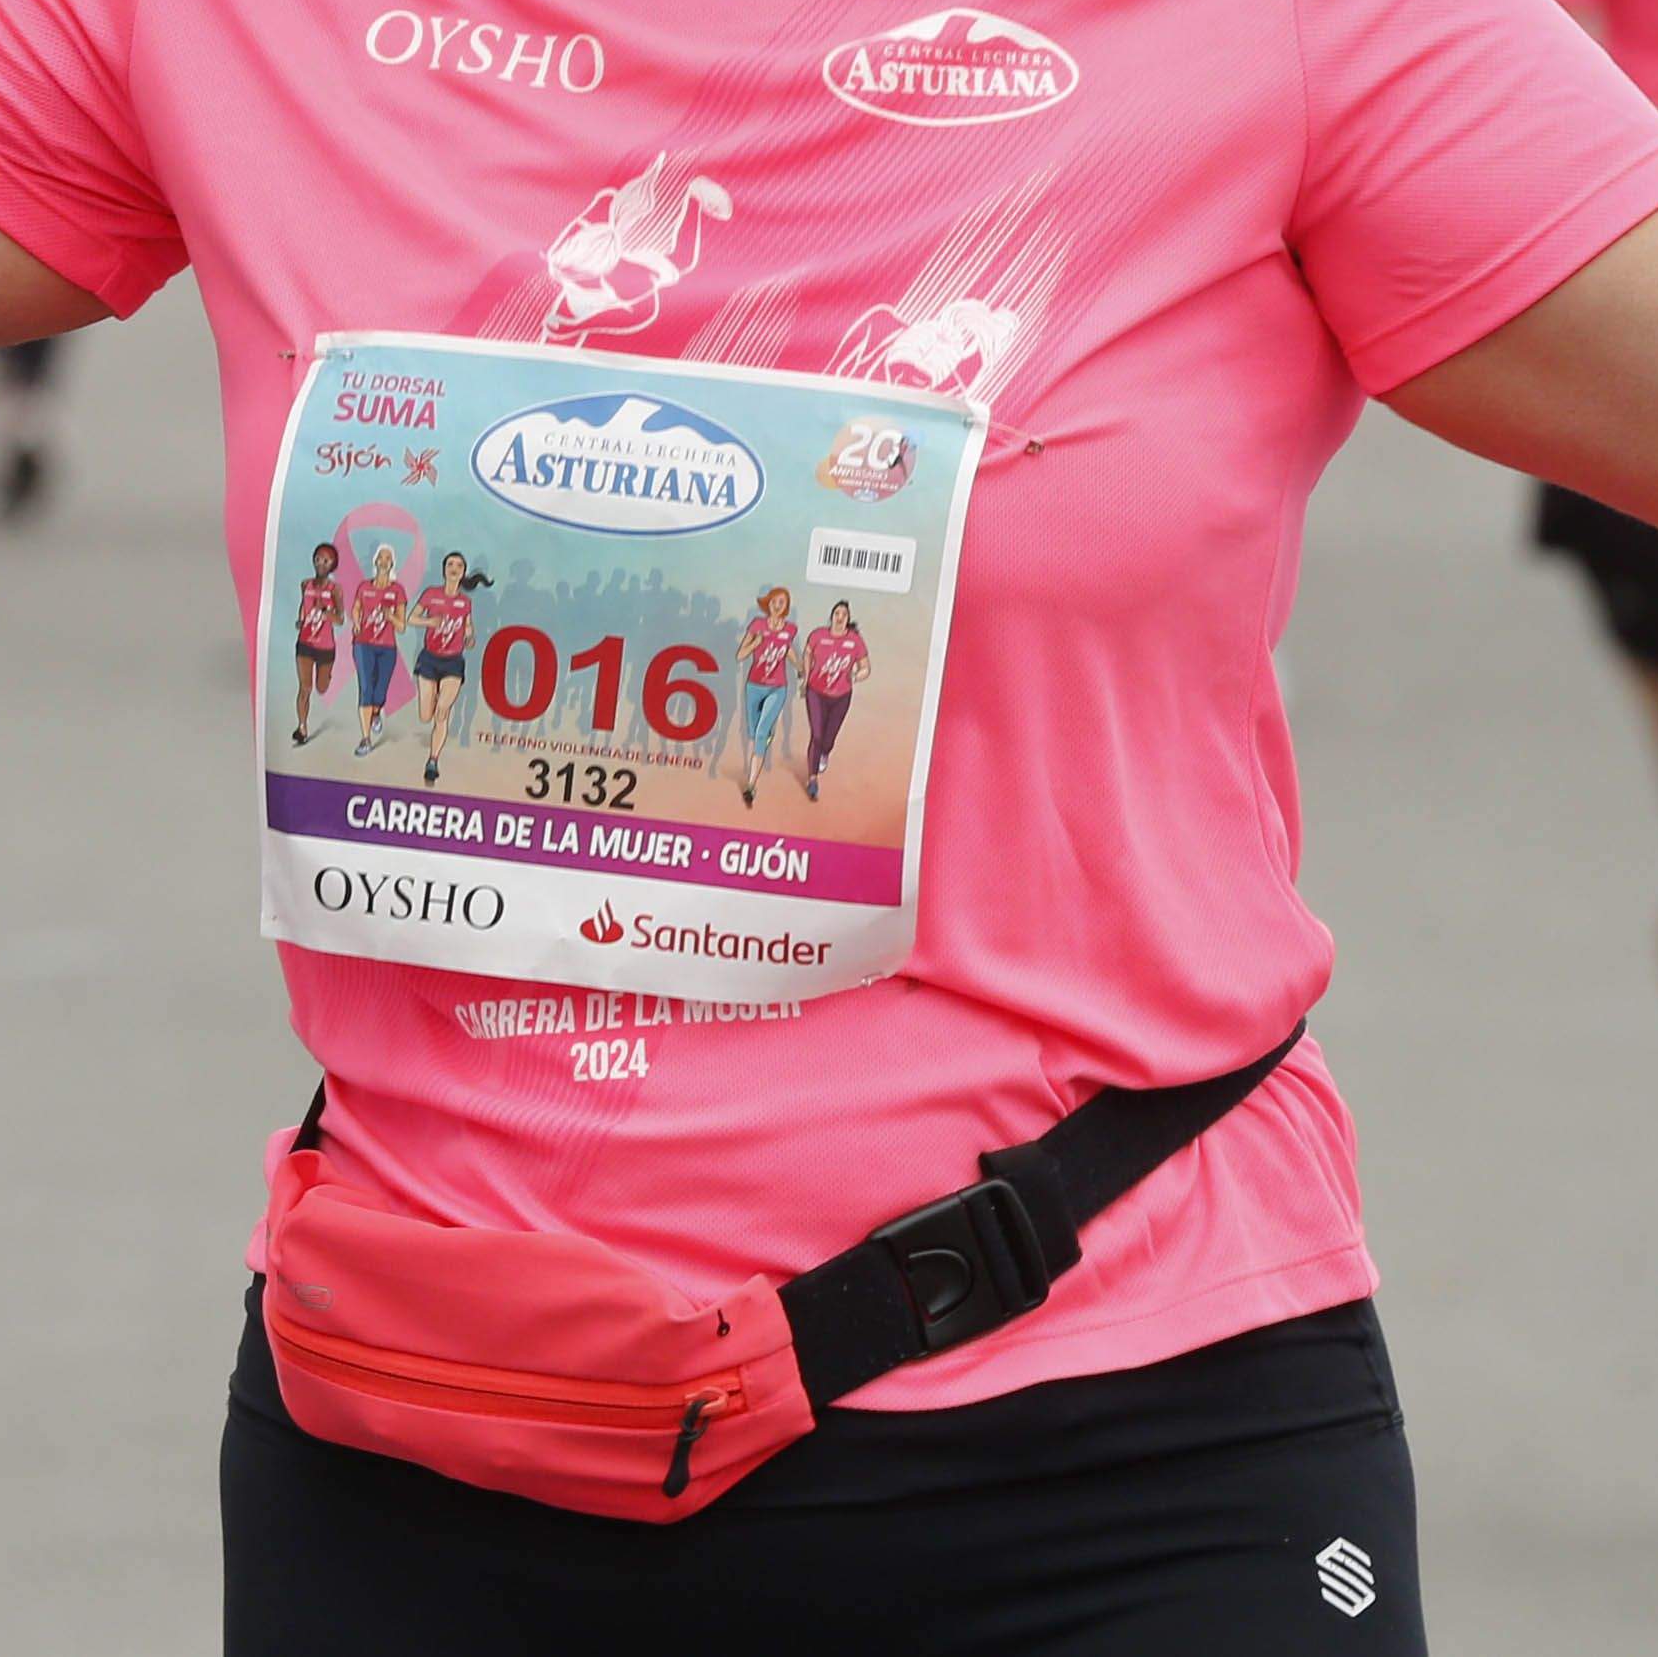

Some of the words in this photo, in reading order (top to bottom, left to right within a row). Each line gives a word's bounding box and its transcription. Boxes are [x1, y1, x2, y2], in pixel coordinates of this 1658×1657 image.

[365, 9, 605, 93] OYSHO
[883, 44, 964, 62] CENTRAL
[971, 49, 1052, 67] LECHERA
[342, 371, 366, 389] TU
[370, 374, 446, 397] DORSAL
[333, 393, 437, 430] SUMA
[314, 442, 392, 478] gijón
[544, 431, 634, 455] CENTRAL
[644, 444, 738, 467] LECHERA
[481, 624, 720, 742] 016
[549, 740, 622, 760] VIOLENCIA
[624, 750, 642, 763] DE
[525, 758, 638, 810] 3132
[345, 795, 485, 843] CARRERA
[494, 813, 536, 848] DE
[542, 819, 581, 855] LA
[589, 825, 693, 868] MUJER
[719, 838, 810, 883] GIJÓN
[313, 865, 505, 931] OYSHO
[630, 913, 832, 966] Santander
[454, 996, 576, 1039] CARRERA
[585, 993, 625, 1031] DE
[634, 993, 673, 1027] LA
[571, 1037, 650, 1082] 2024
